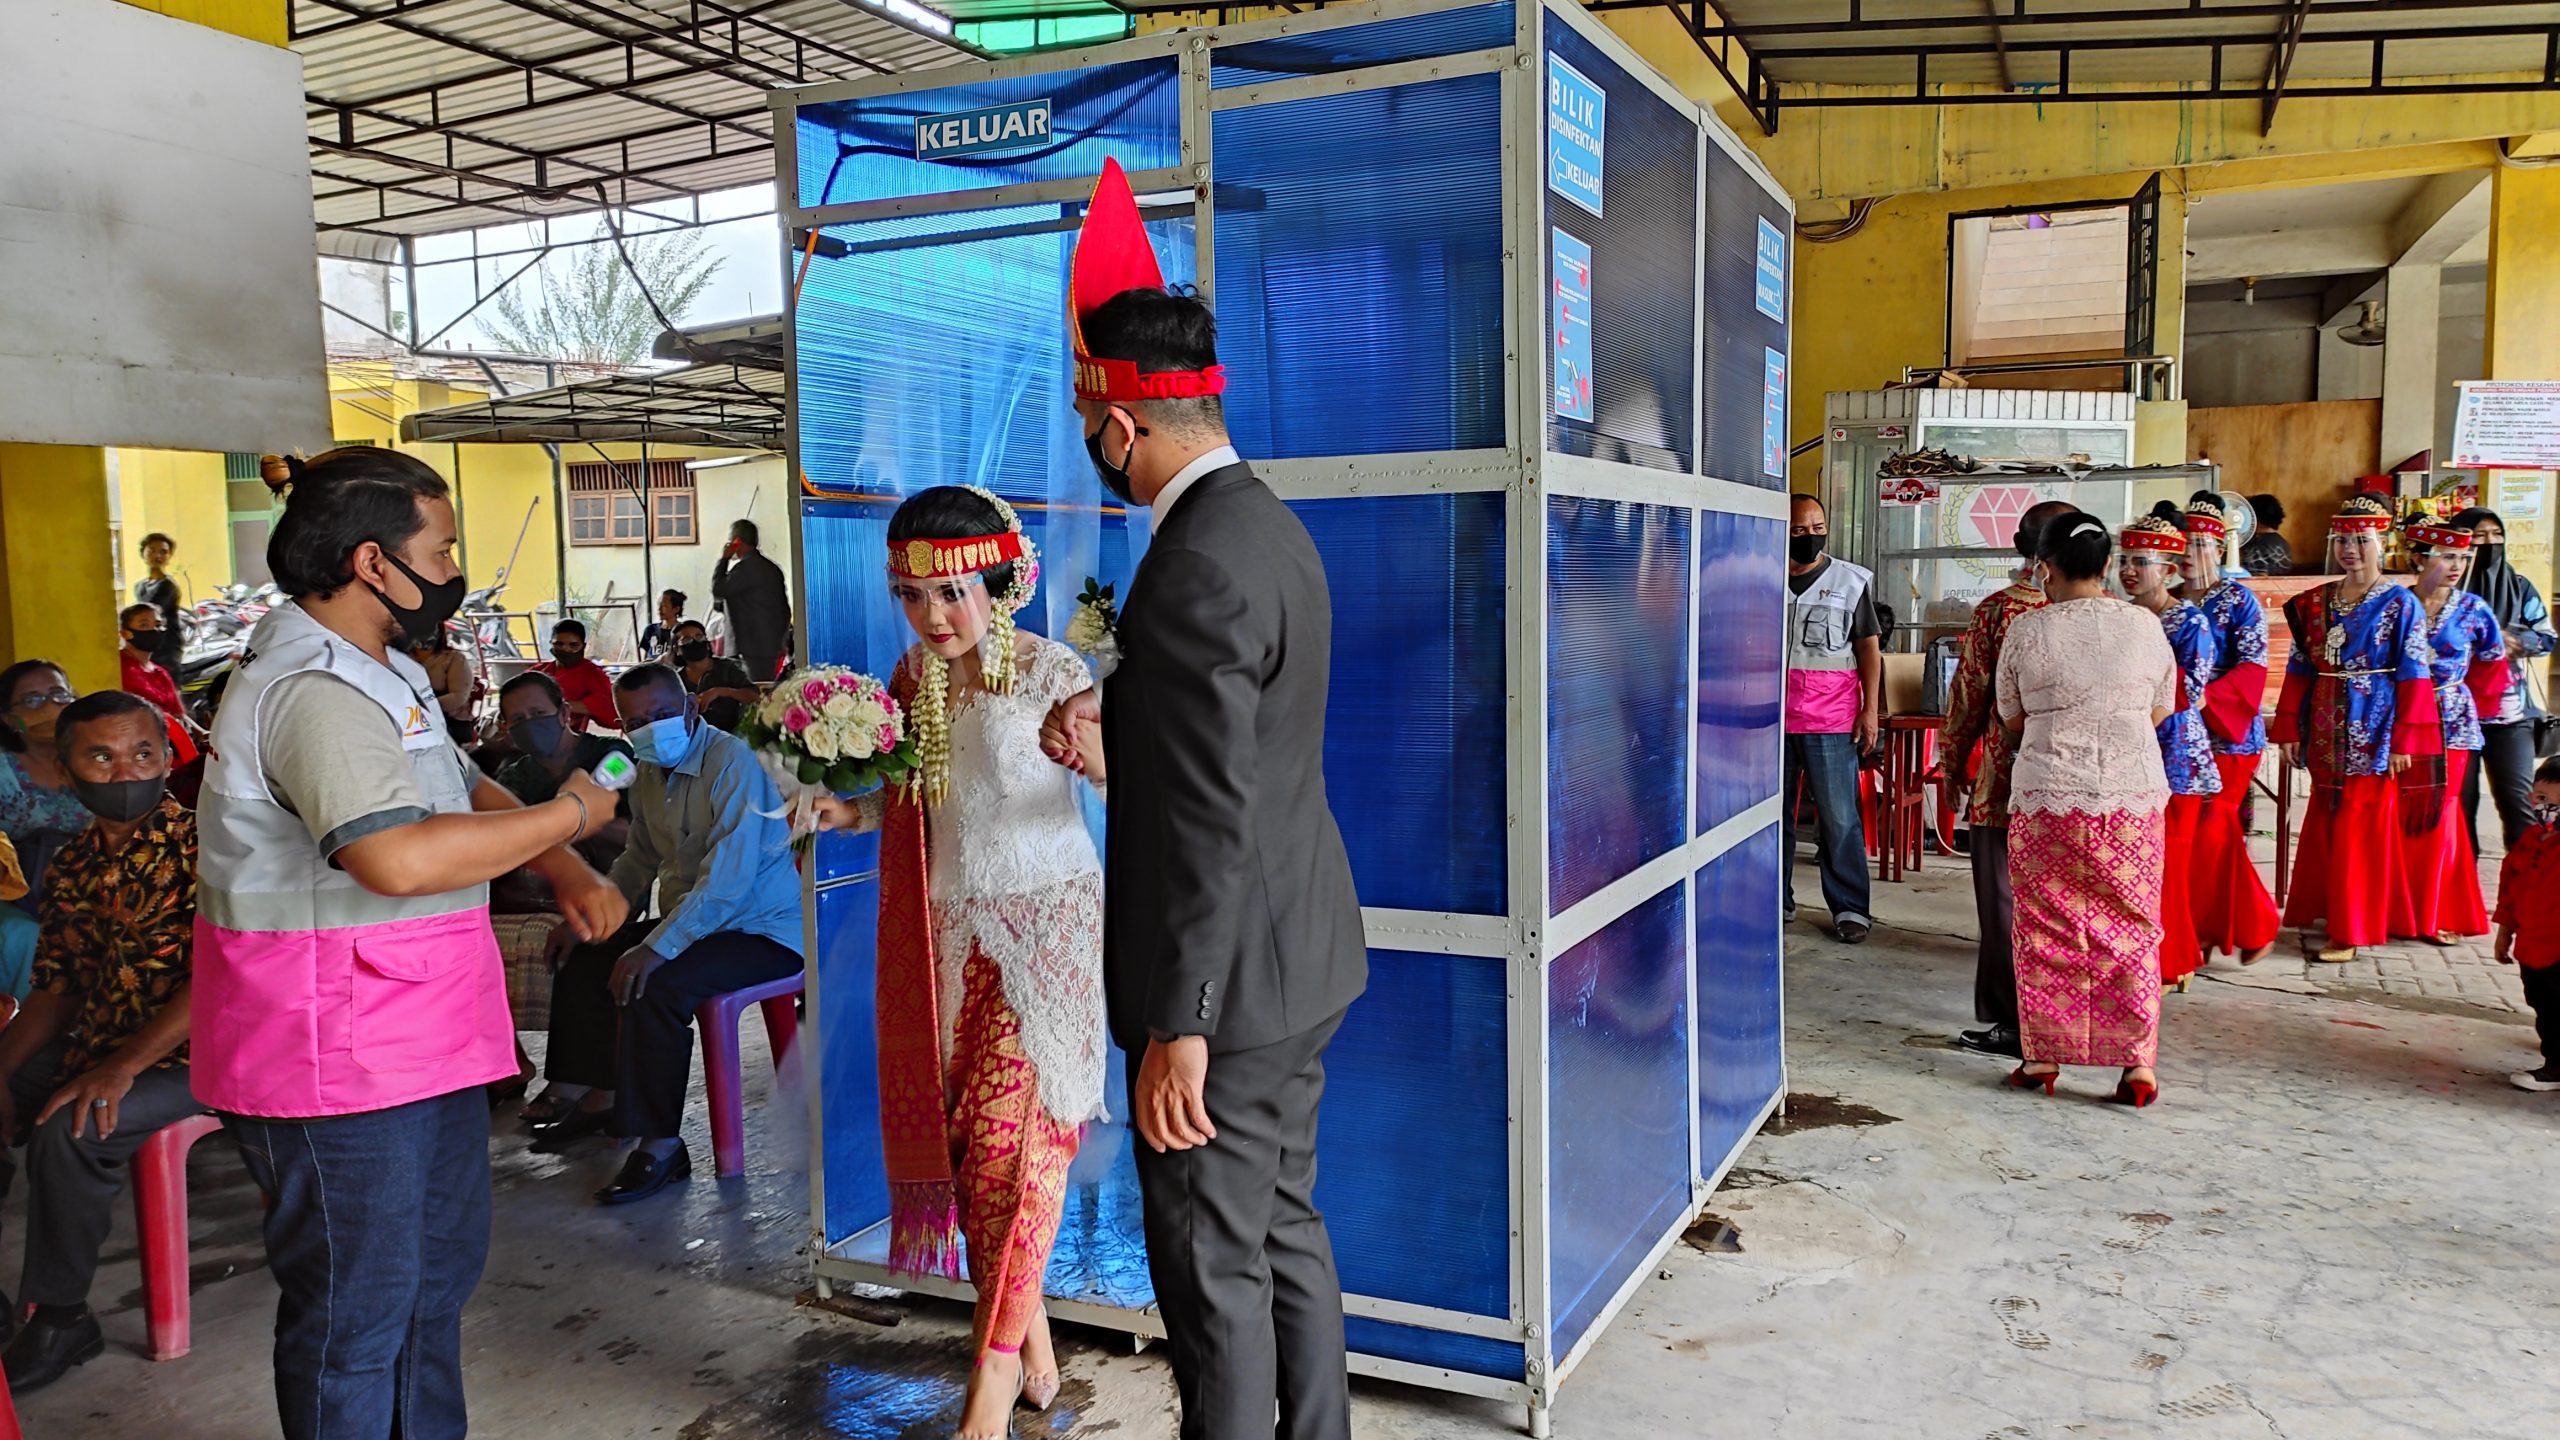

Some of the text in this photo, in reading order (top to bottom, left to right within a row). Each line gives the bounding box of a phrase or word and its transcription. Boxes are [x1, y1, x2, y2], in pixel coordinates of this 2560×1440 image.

[1552, 75, 1594, 130] BILIK
[920, 108, 1047, 150] KELUAR
[1551, 112, 1600, 158] DISINFEKTAN
[1567, 161, 1600, 196] KELUAR
[1759, 231, 1780, 263] BILIK
[1943, 589, 1985, 597] KOPERASI
